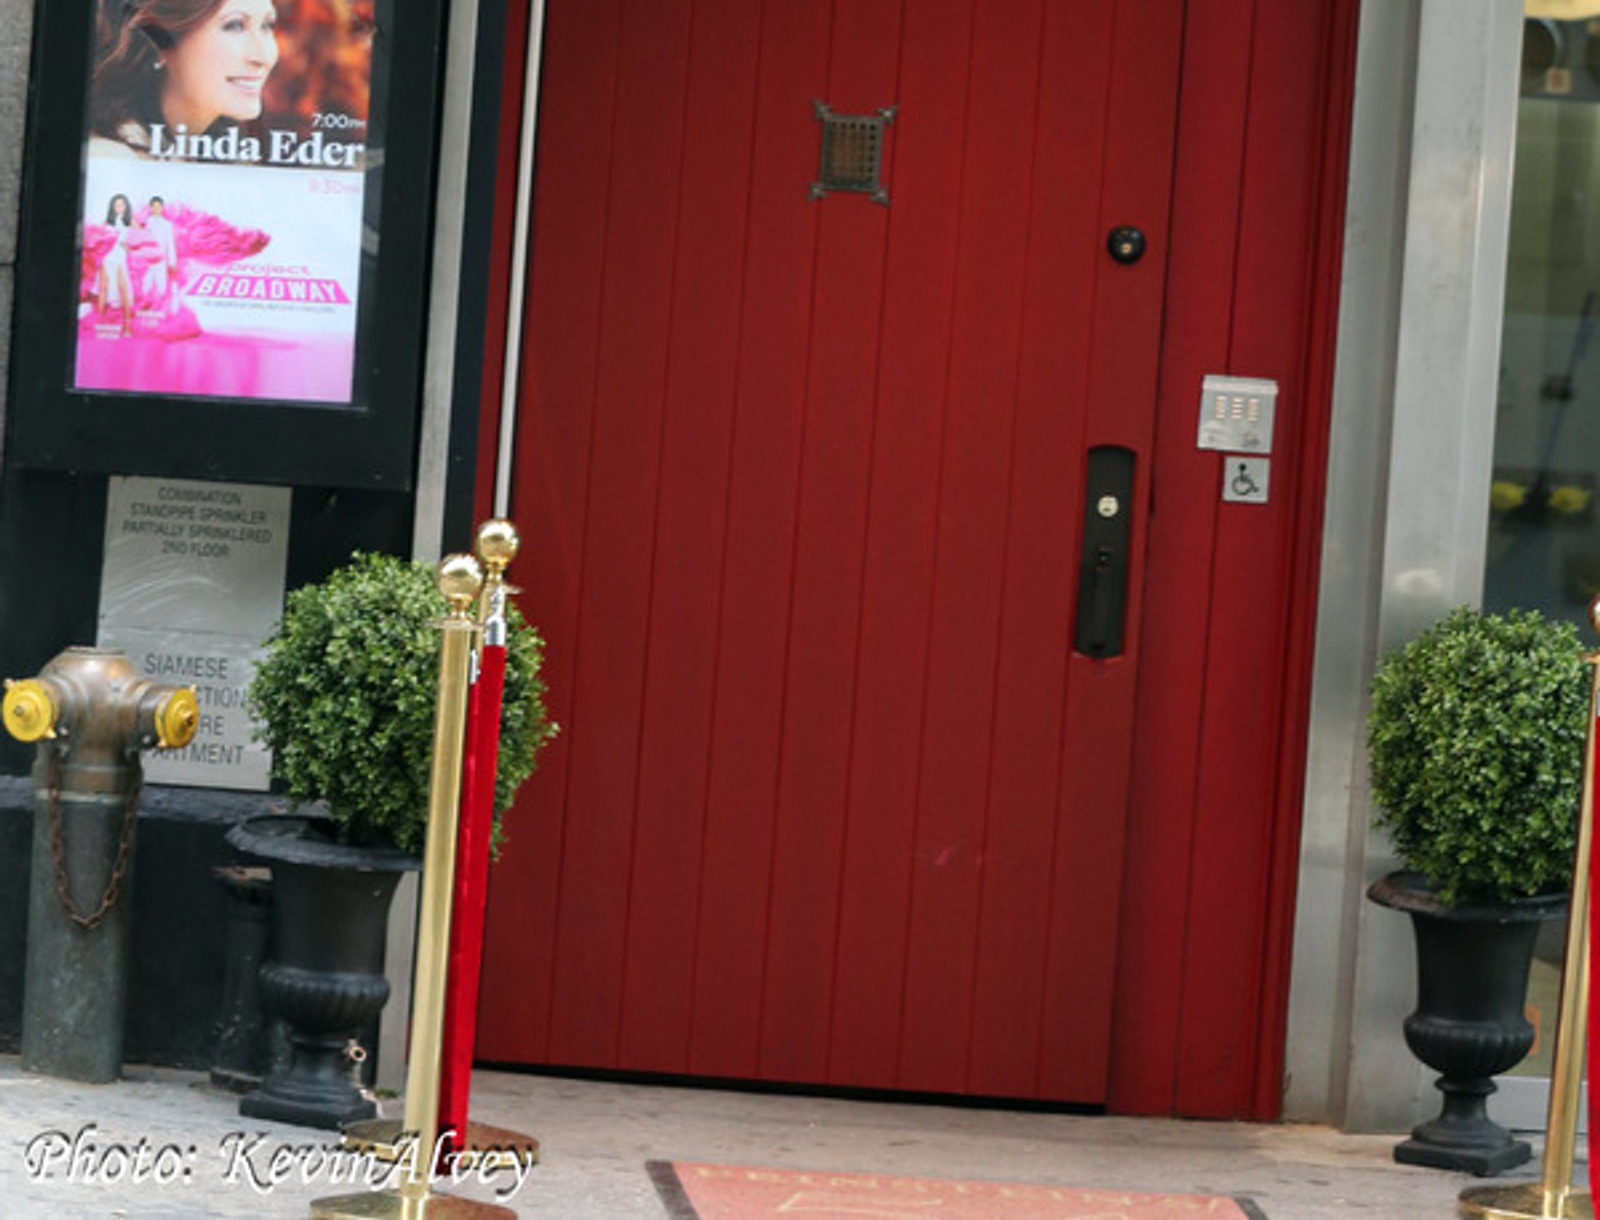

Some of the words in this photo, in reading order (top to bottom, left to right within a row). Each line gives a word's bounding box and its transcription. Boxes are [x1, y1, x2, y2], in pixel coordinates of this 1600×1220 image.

[149, 123, 261, 162] Linda
[268, 130, 365, 167] Eder
[197, 275, 338, 302] BROADWAY
[158, 486, 242, 506] COMBINATION
[130, 502, 196, 520] STANDPIPE
[199, 508, 266, 524] SPRINKLER
[122, 520, 184, 536] PARTIALLY
[188, 525, 273, 544] SPRINKLERED
[190, 542, 231, 557] FLOOR
[144, 652, 229, 680] SIAMESE
